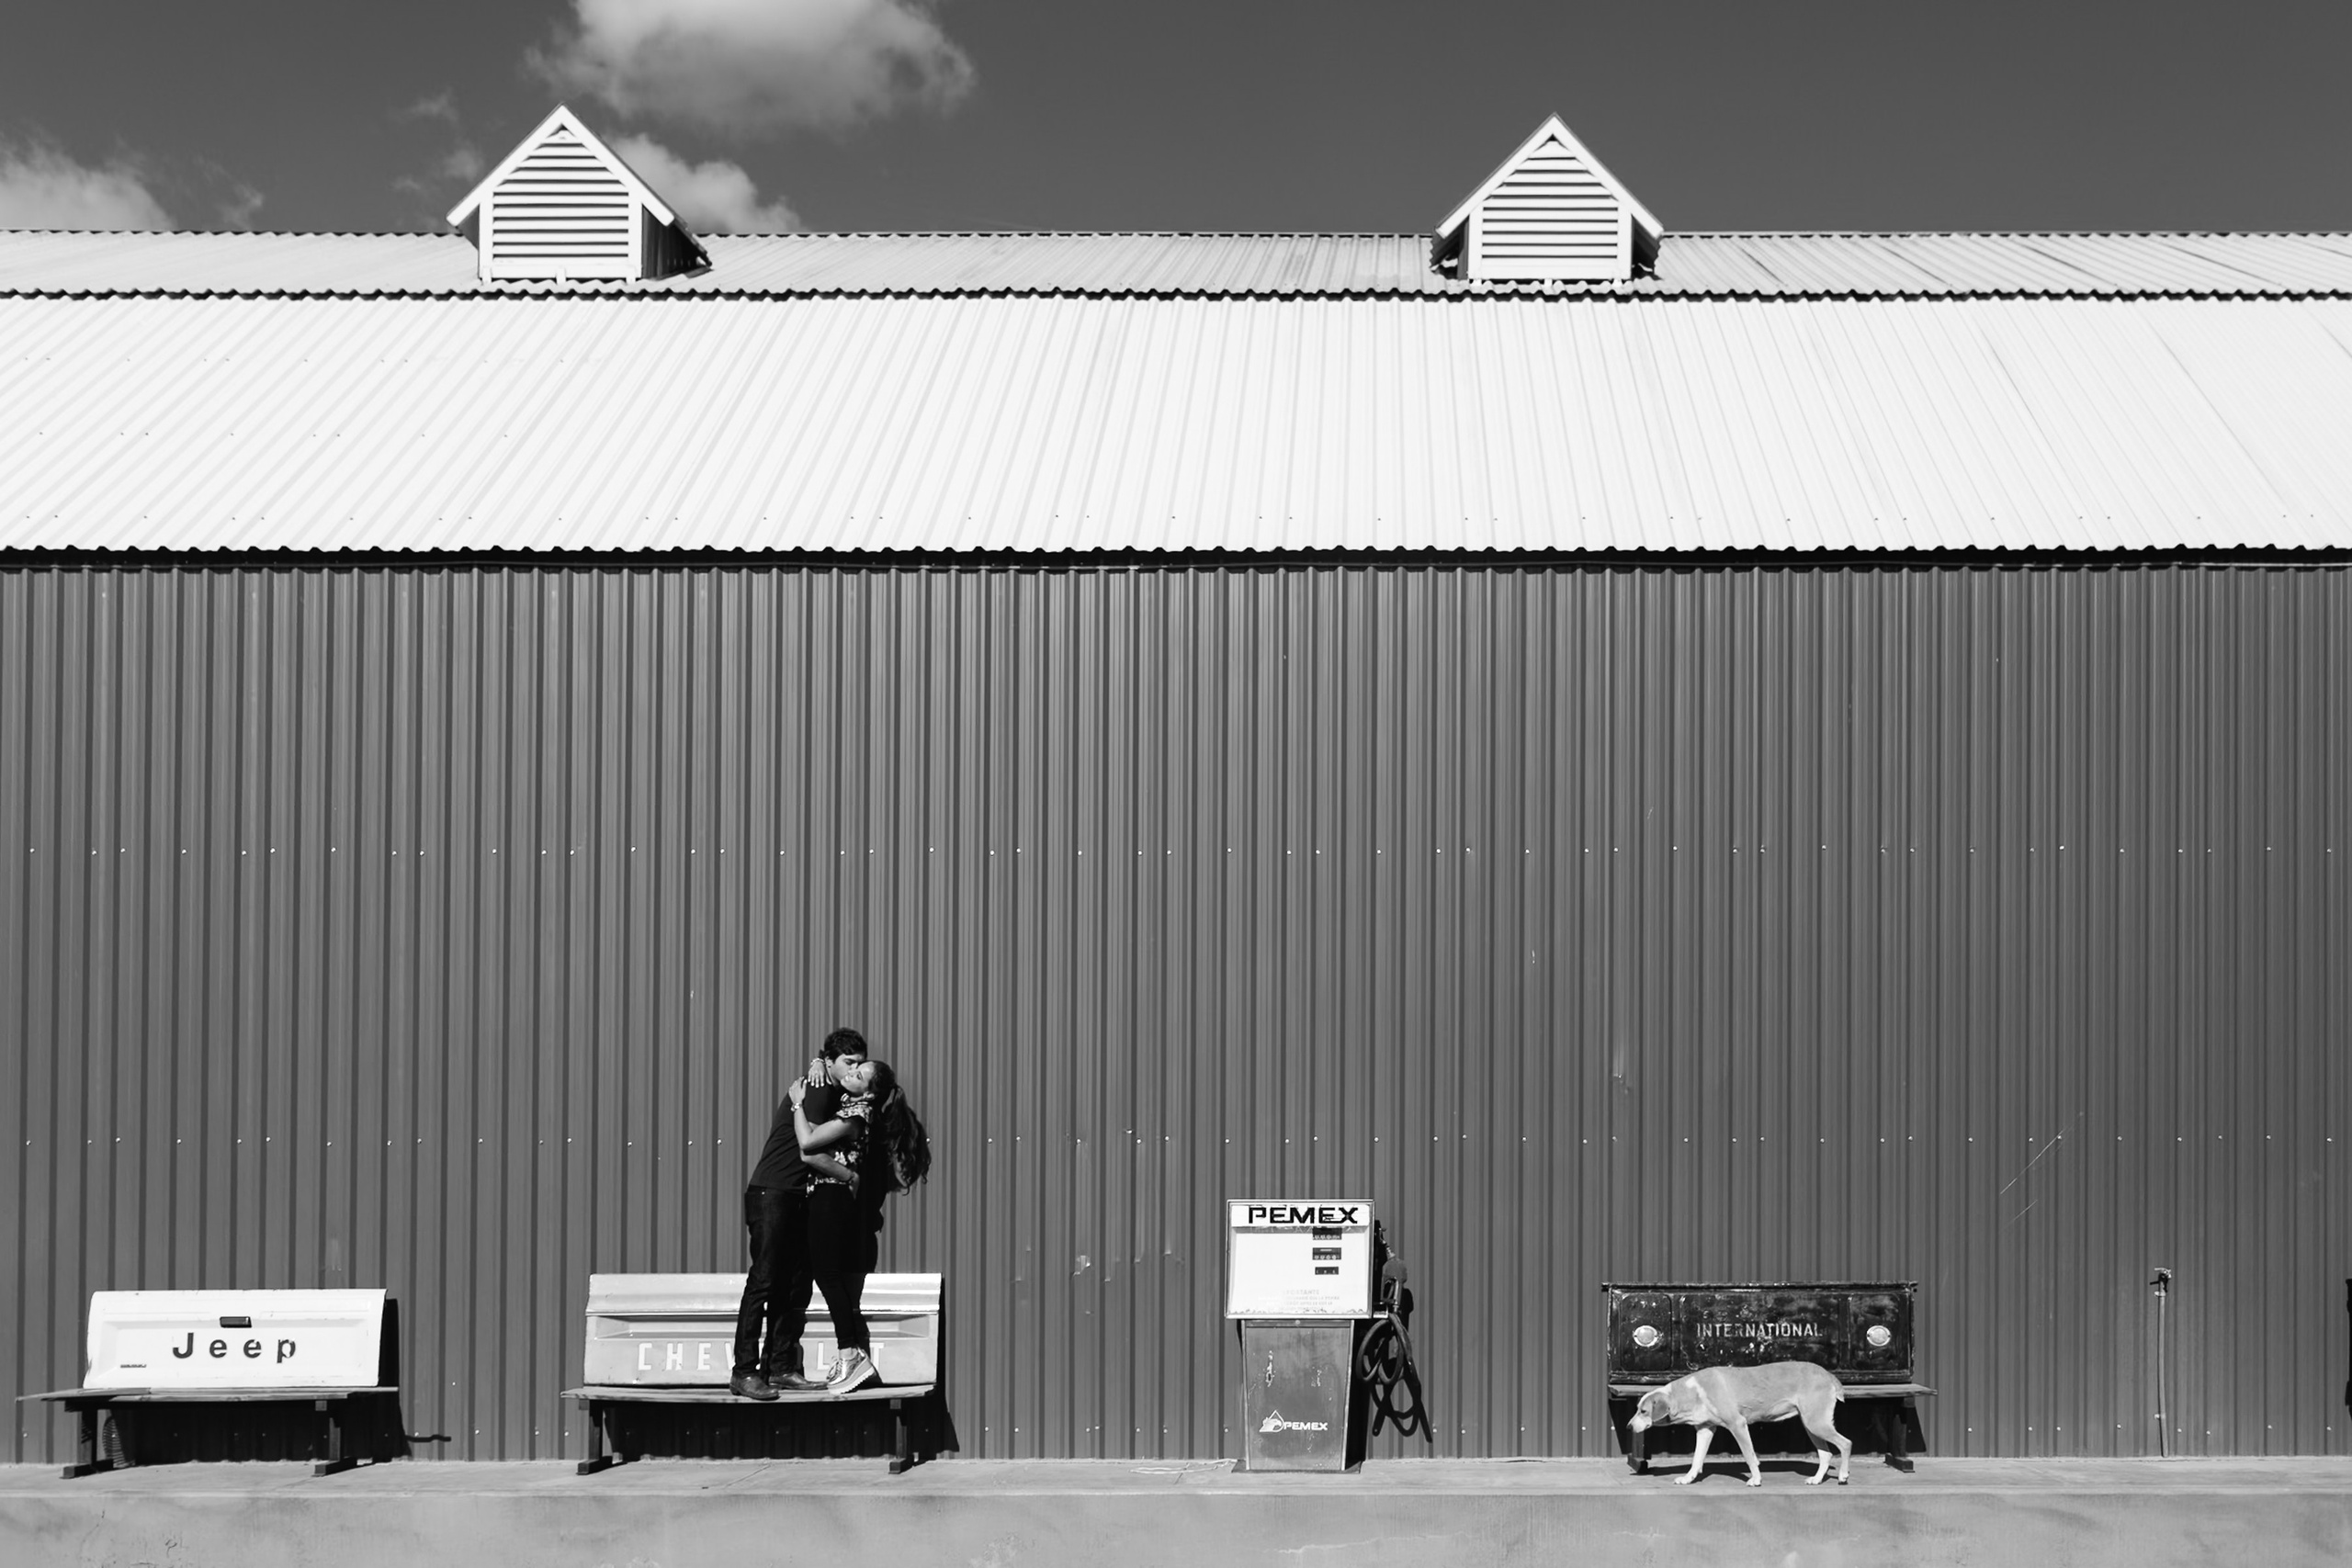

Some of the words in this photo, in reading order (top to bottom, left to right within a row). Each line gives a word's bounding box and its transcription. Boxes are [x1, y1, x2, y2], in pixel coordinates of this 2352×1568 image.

[1248, 1206, 1359, 1224] PEMEX
[1696, 1322, 1824, 1337] INTERNATIONAL
[172, 1332, 297, 1364] Jeep
[638, 1342, 885, 1371] CHEVLT
[1283, 1421, 1329, 1431] PEMEX
